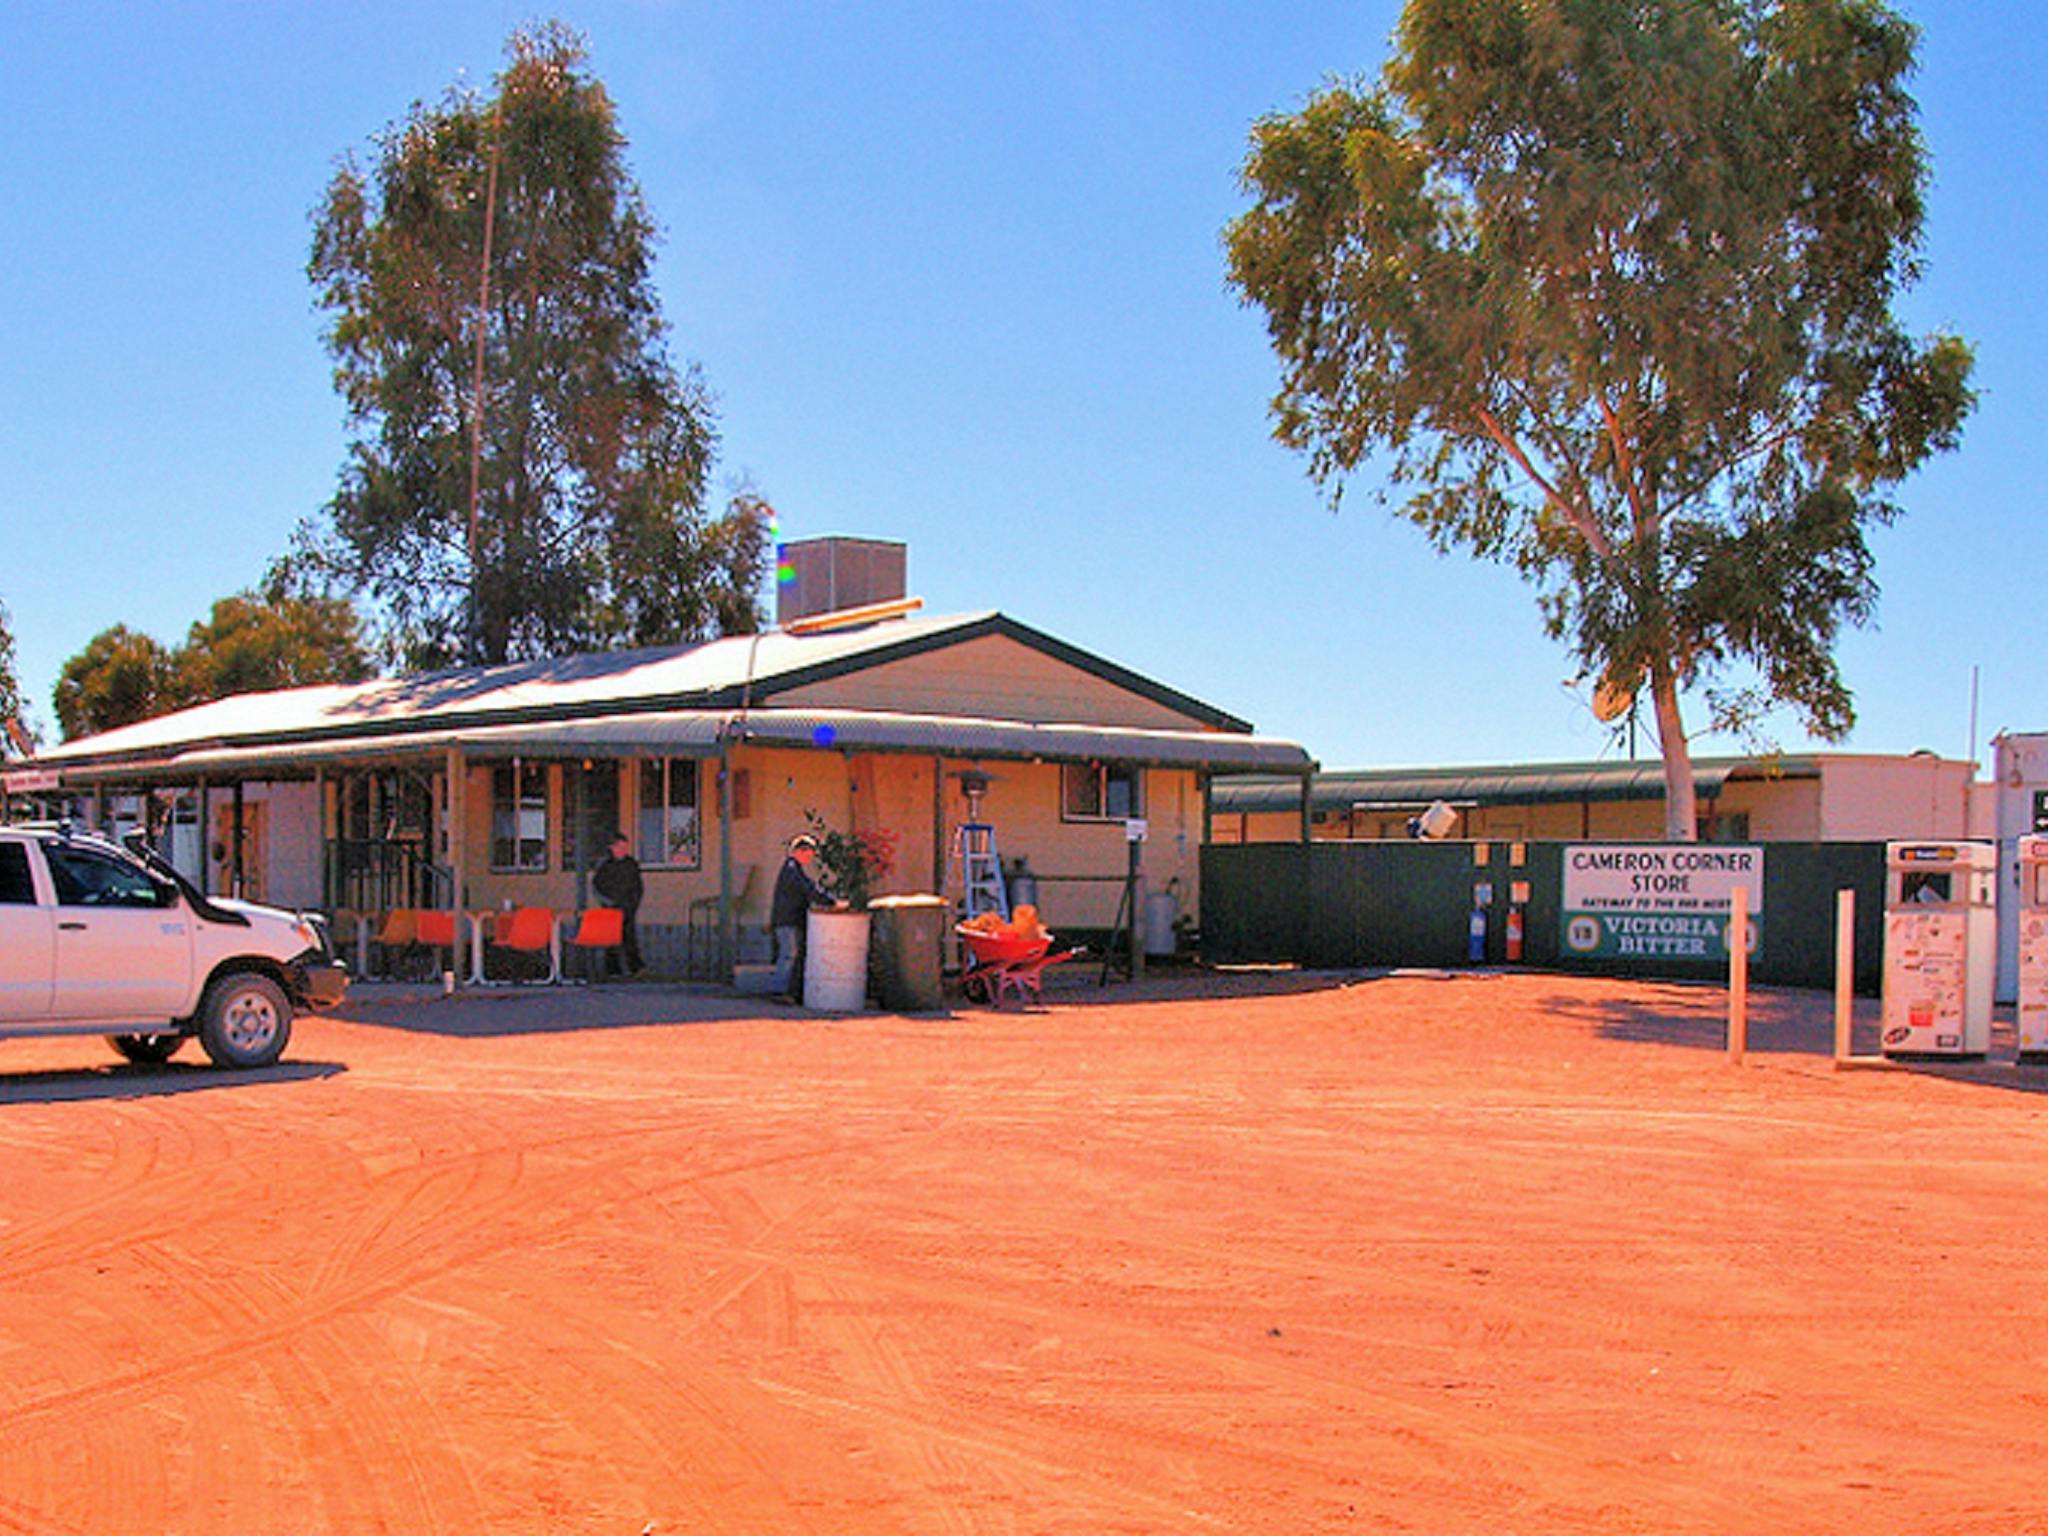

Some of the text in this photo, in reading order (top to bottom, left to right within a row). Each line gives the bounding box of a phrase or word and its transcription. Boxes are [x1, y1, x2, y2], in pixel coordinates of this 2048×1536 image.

[1572, 852, 1753, 871] CAMERON CORNER
[1630, 875, 1691, 893] STORE
[1603, 916, 1719, 935] VICTORIA
[1618, 936, 1706, 955] BITTER
